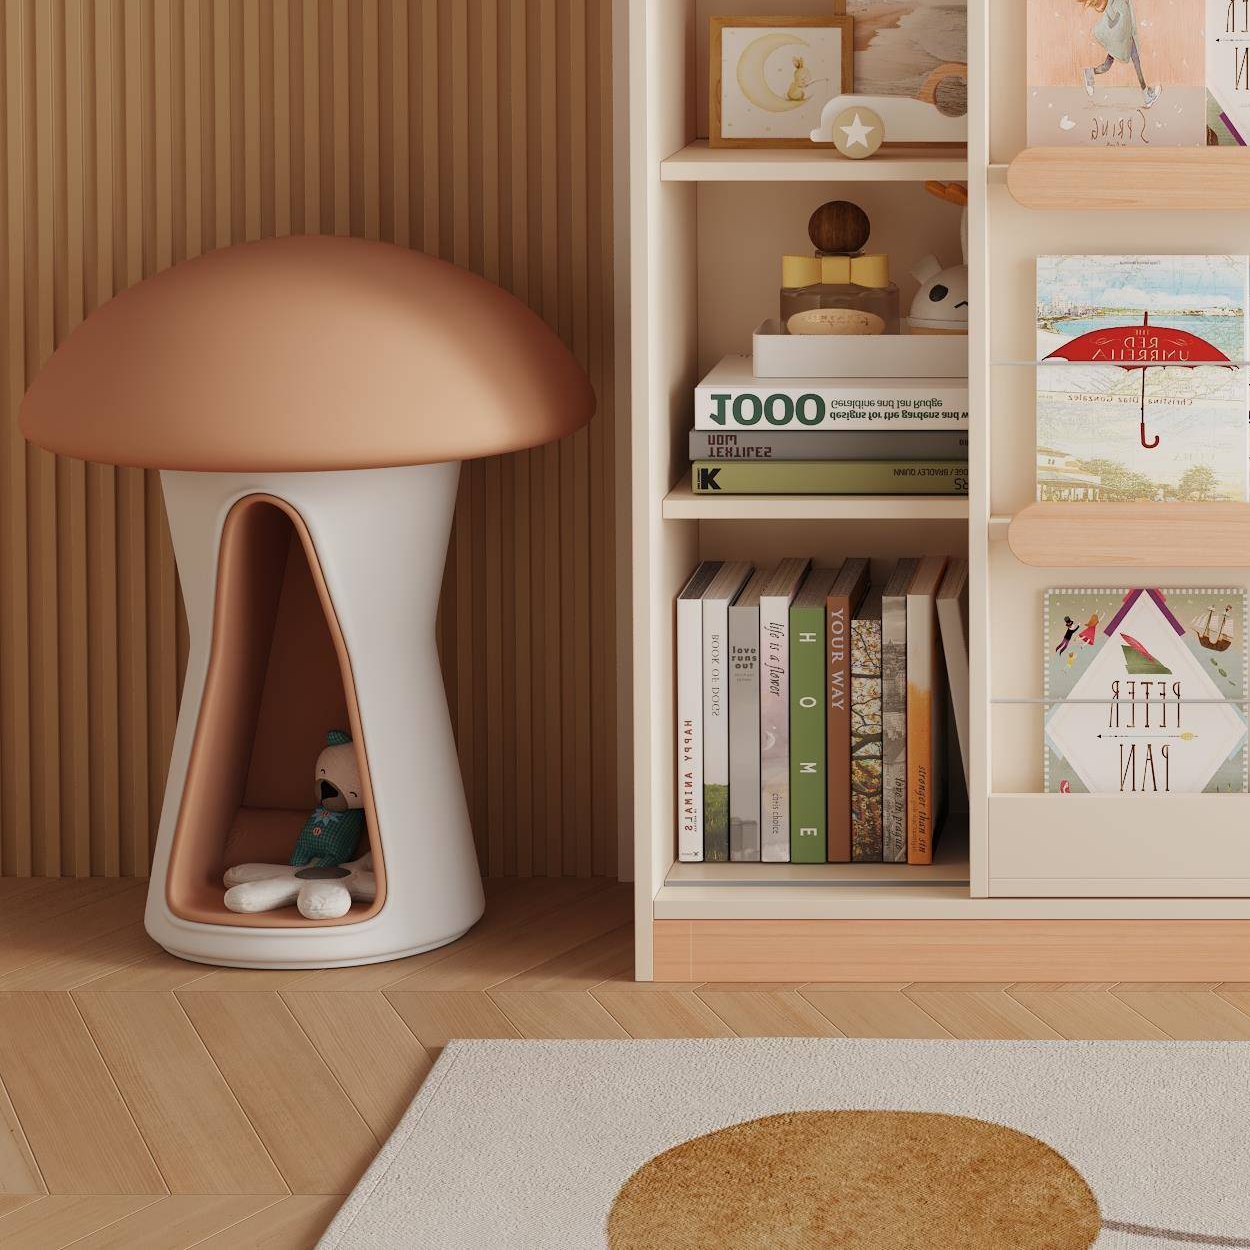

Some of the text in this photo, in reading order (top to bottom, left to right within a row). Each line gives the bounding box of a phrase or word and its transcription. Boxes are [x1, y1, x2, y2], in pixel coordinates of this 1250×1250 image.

[701, 468, 722, 490] K
[764, 622, 784, 639] life
[732, 646, 757, 654] love
[770, 642, 784, 650] is
[831, 607, 844, 711] YOUR WAY
[764, 663, 785, 697] flower
[772, 793, 783, 834] chris choice
